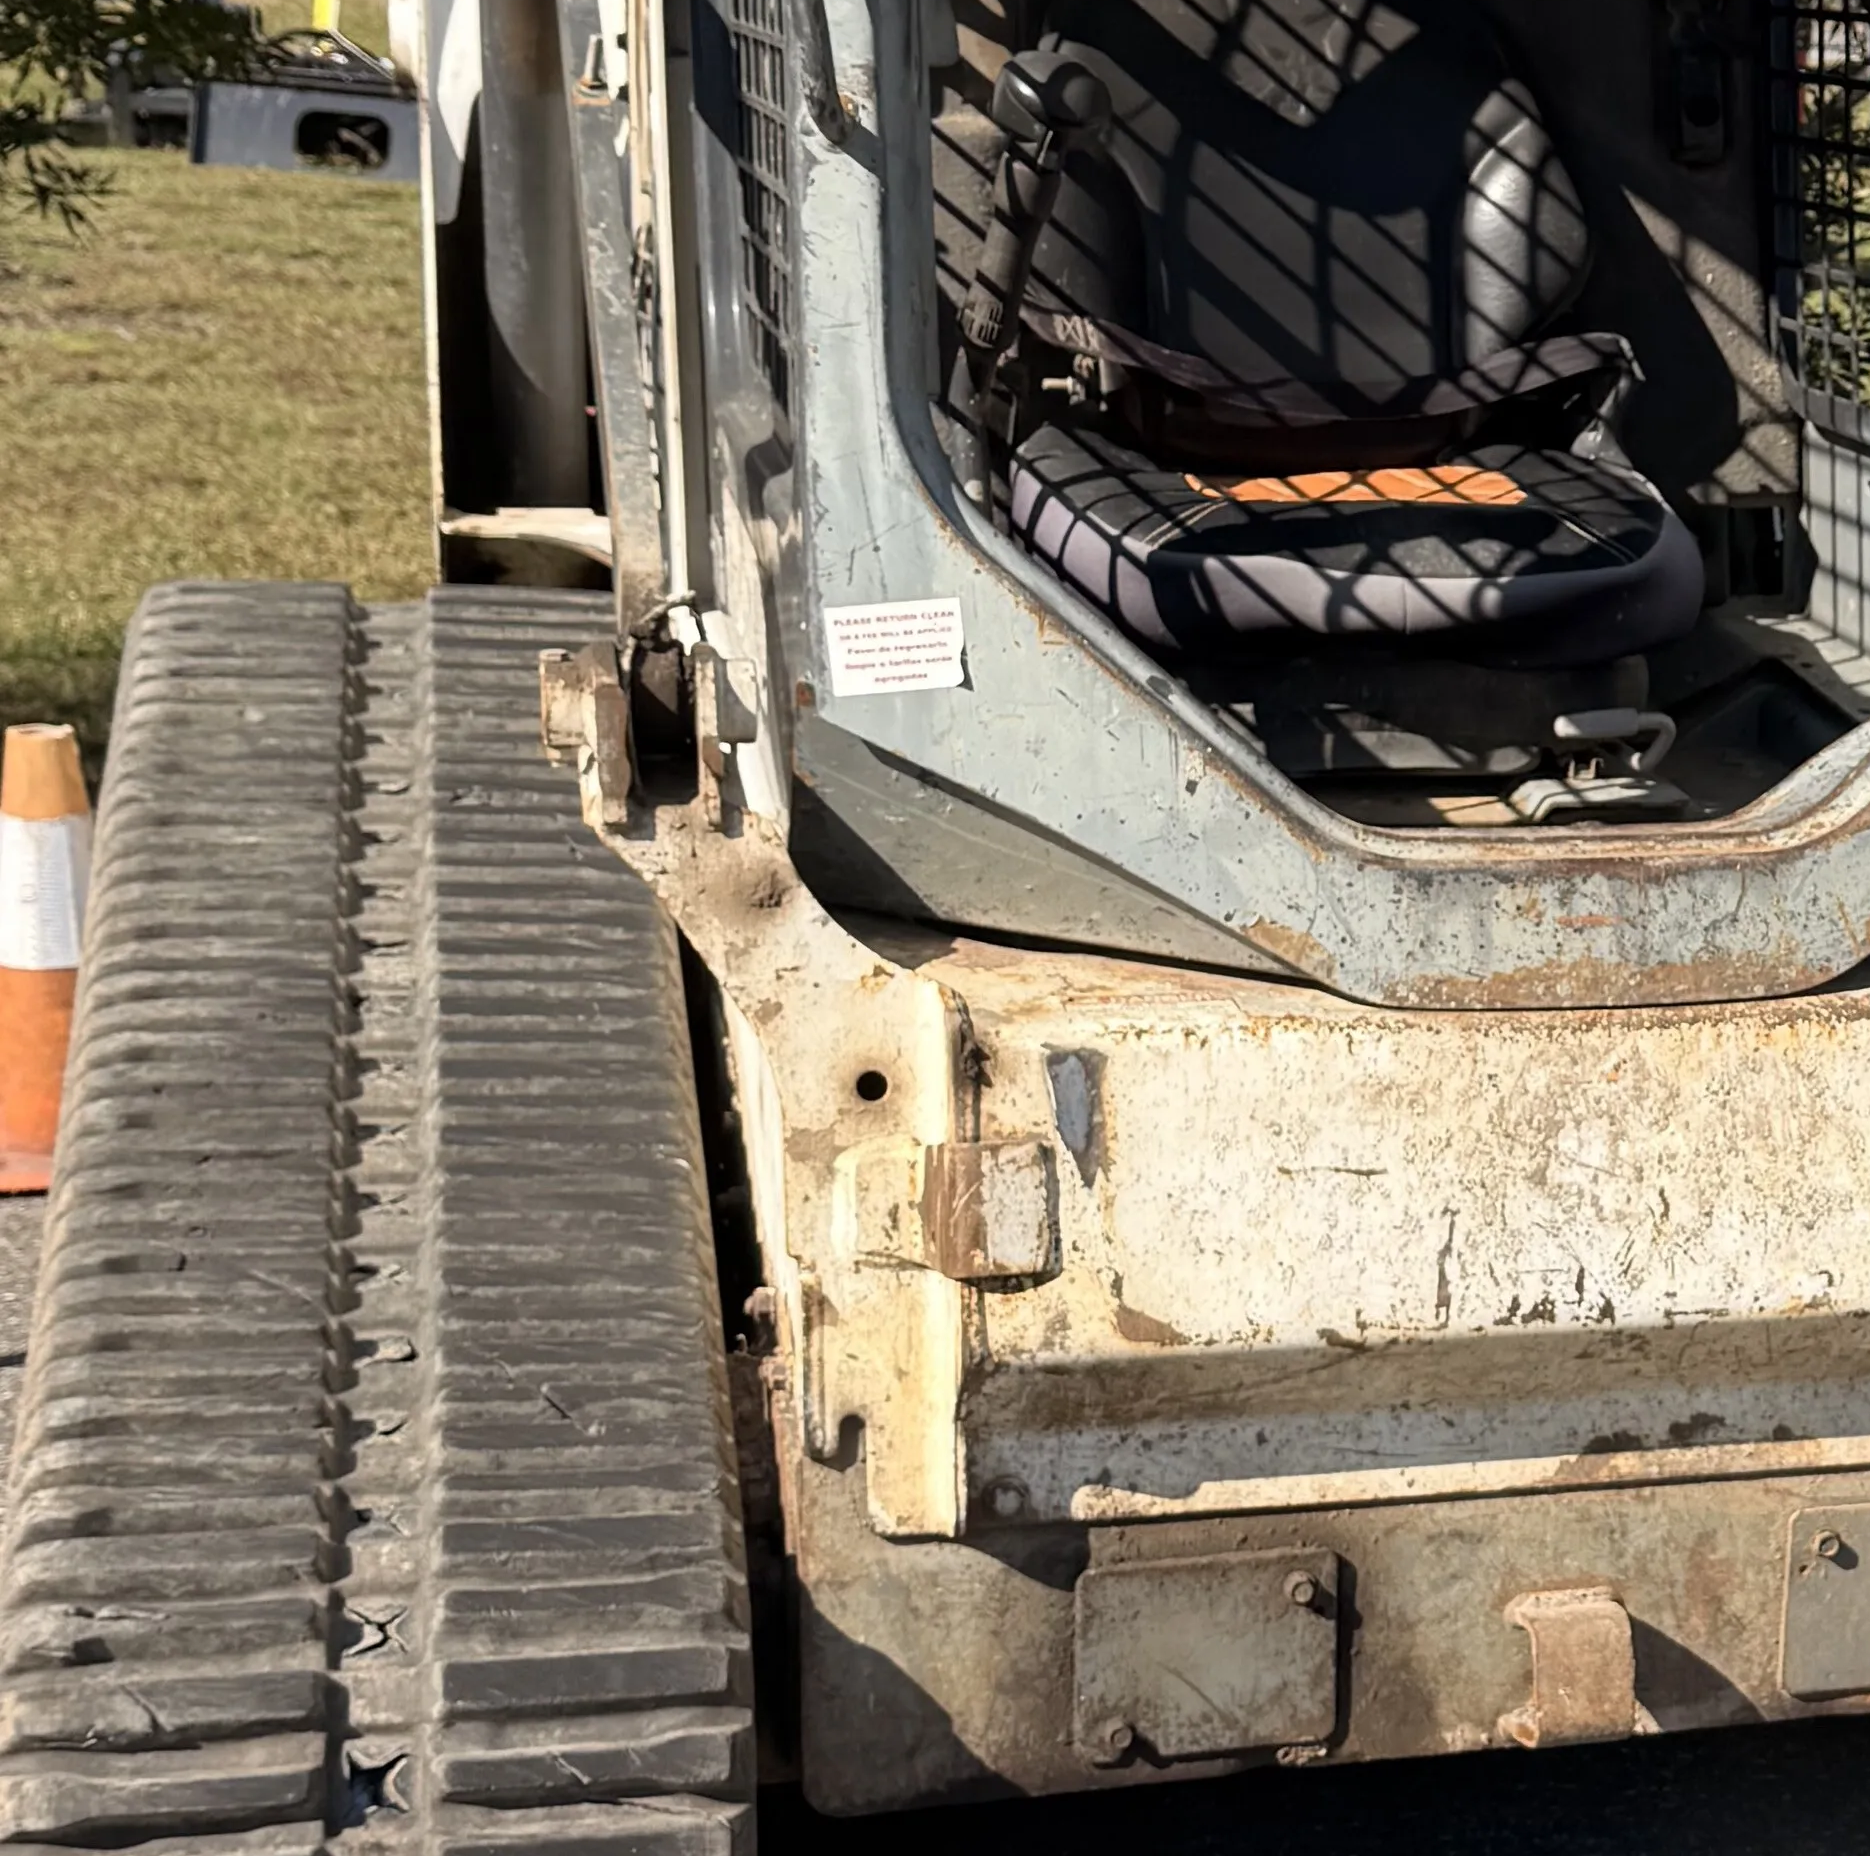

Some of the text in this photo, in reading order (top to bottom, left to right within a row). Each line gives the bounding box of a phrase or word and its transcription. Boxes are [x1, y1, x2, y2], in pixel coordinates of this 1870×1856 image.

[833, 611, 955, 627] PLEASE RETURN CLEAN
